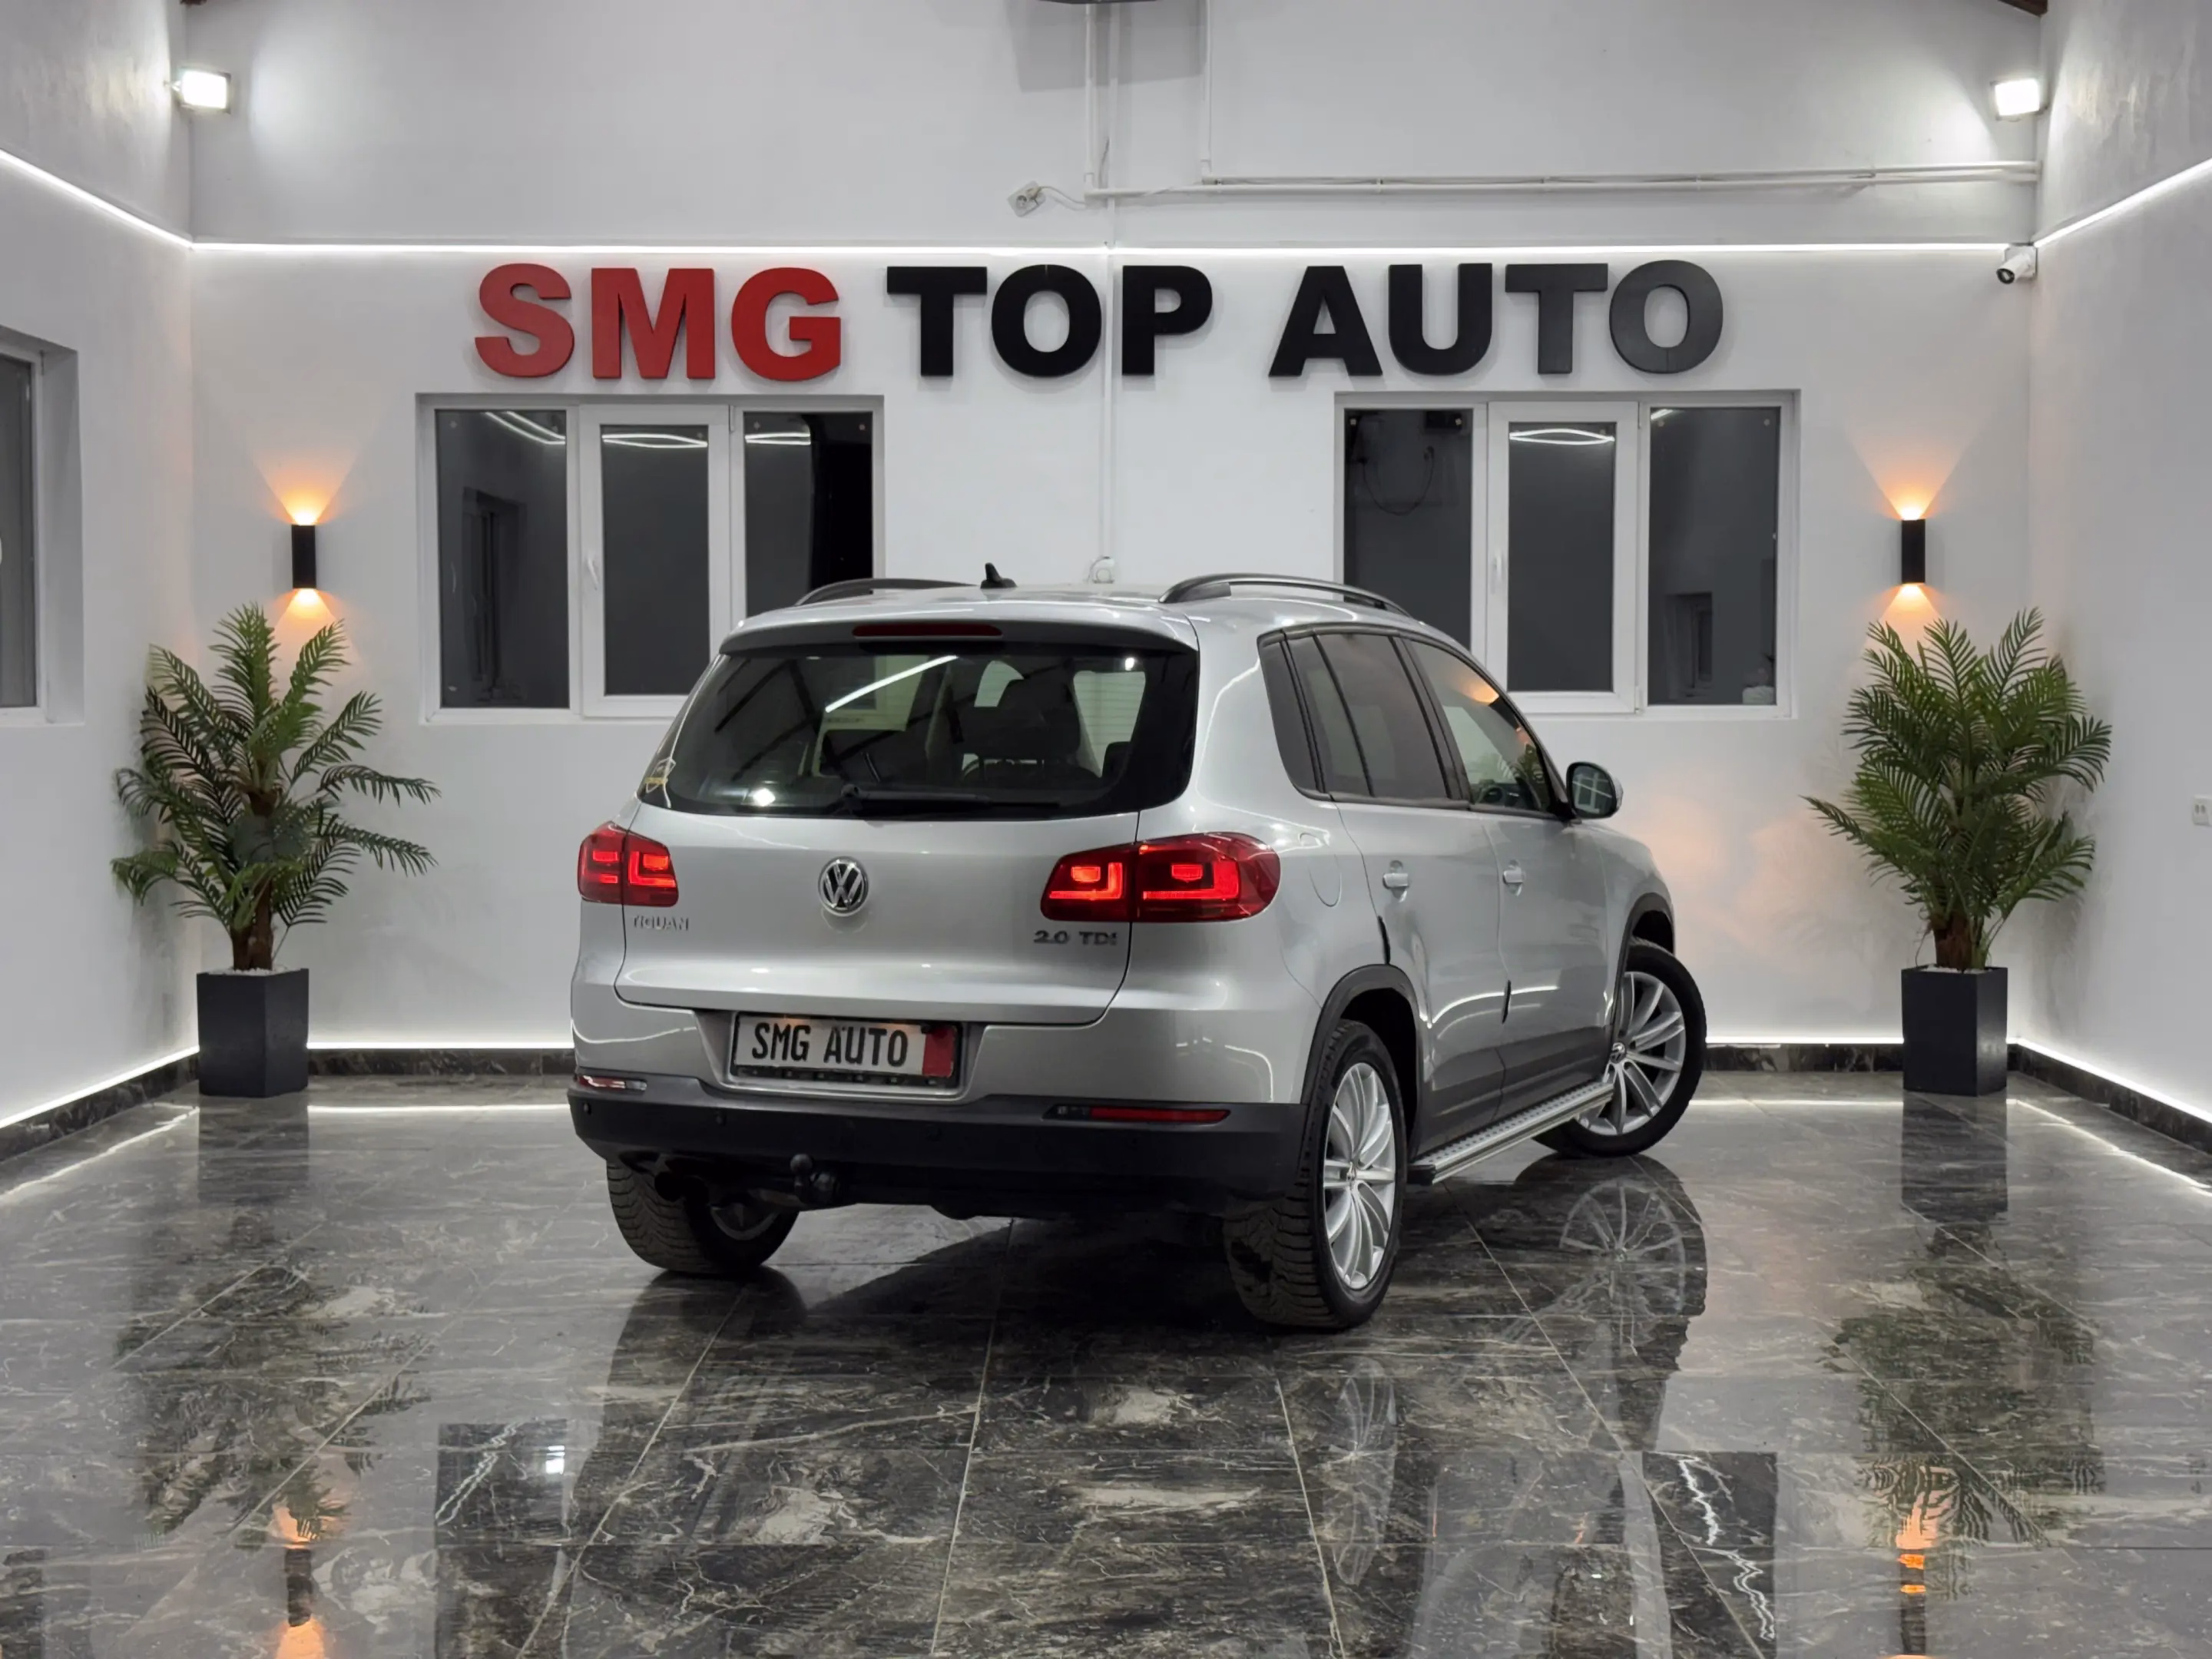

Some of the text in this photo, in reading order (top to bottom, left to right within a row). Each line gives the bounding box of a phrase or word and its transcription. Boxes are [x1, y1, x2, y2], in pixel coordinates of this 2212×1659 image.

[474, 260, 1724, 382] SMG TOP AUTO
[1079, 931, 1118, 945] TDI
[751, 1022, 908, 1067] SMG AUTO
